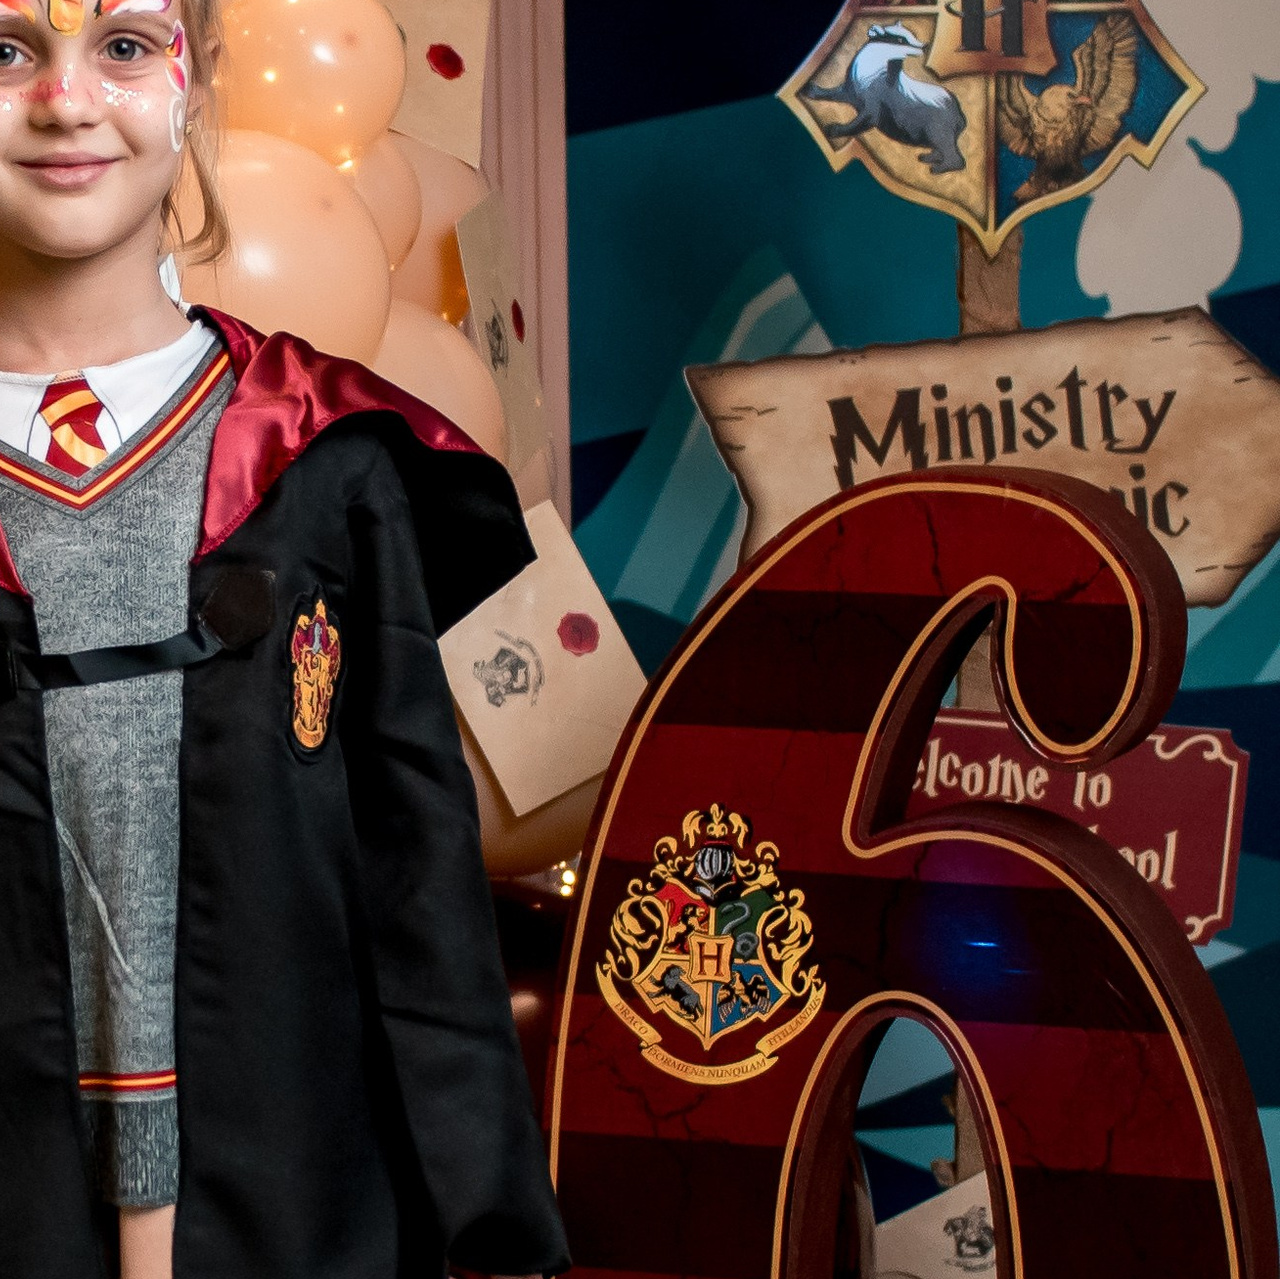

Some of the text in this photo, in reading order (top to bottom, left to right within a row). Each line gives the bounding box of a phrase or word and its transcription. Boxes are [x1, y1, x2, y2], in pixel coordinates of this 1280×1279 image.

[826, 365, 1178, 492] Ministry
[912, 737, 1049, 804] lcome
[614, 1001, 649, 1036] DRACO
[647, 1044, 767, 1079] DORMIENS NUNQUAM
